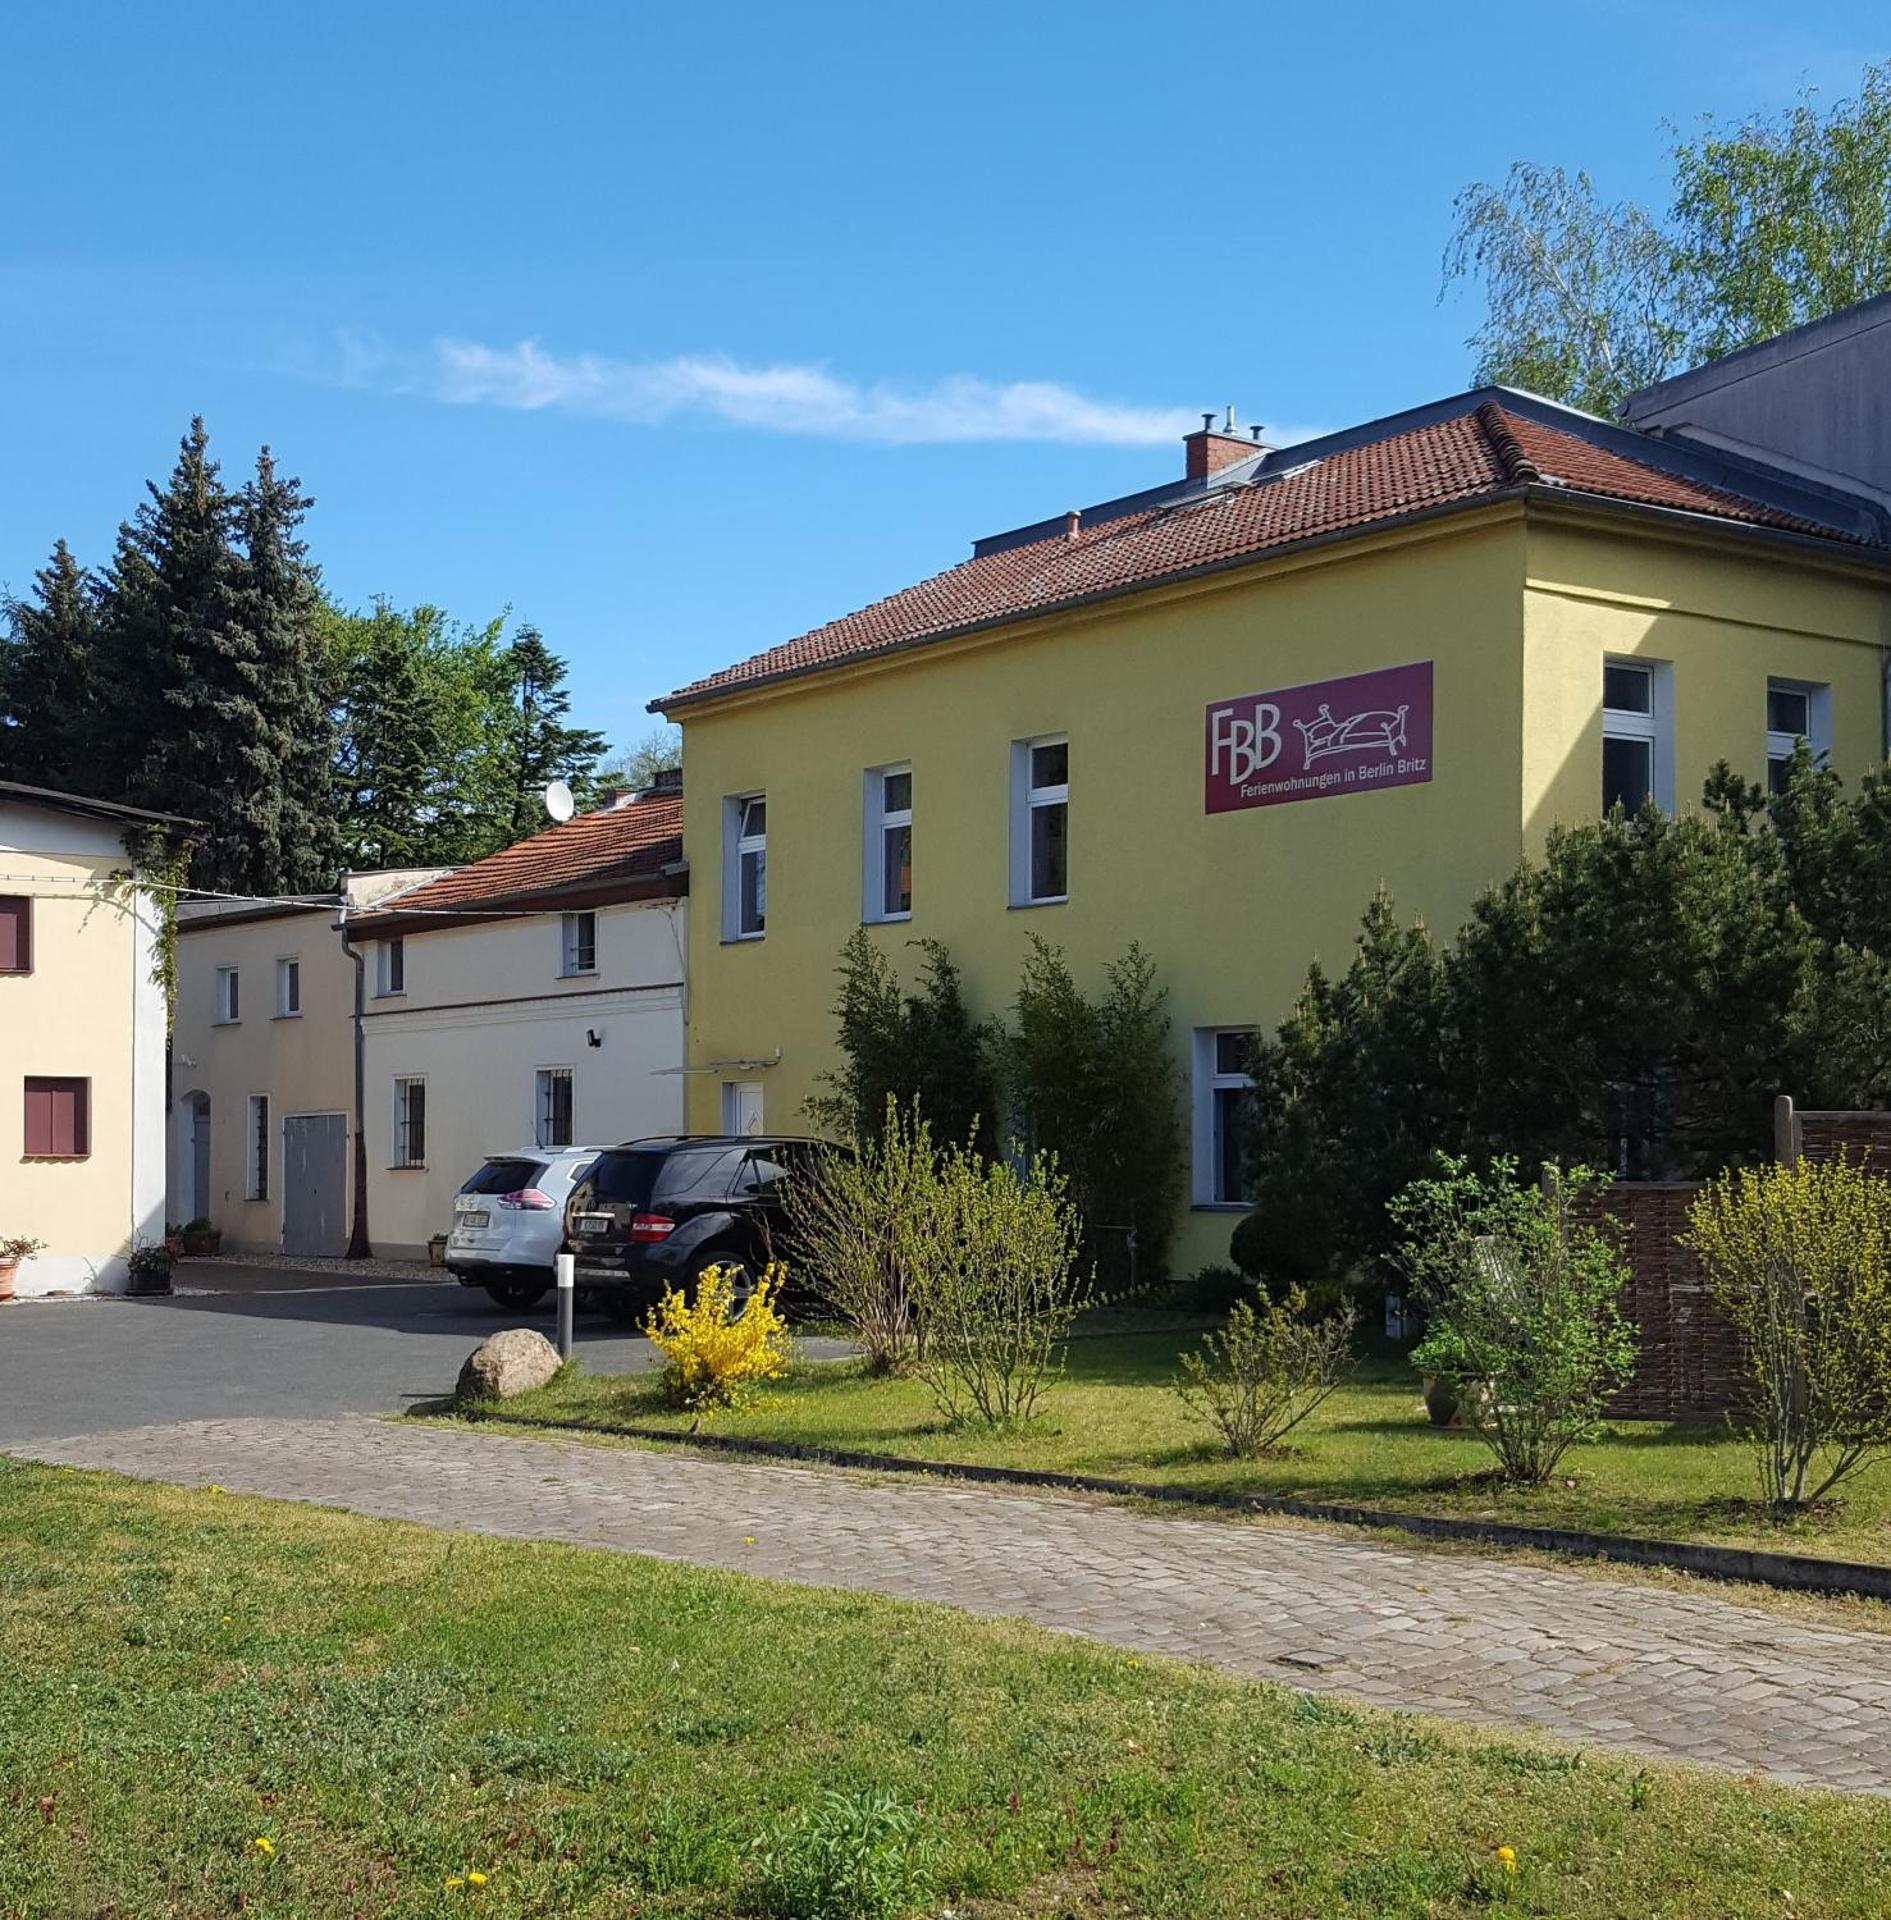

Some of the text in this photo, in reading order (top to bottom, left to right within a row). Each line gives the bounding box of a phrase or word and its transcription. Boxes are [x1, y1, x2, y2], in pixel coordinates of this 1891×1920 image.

[1211, 703, 1282, 785] FBB
[1240, 758, 1427, 798] Ferienwohnungen in Berlin Britz
